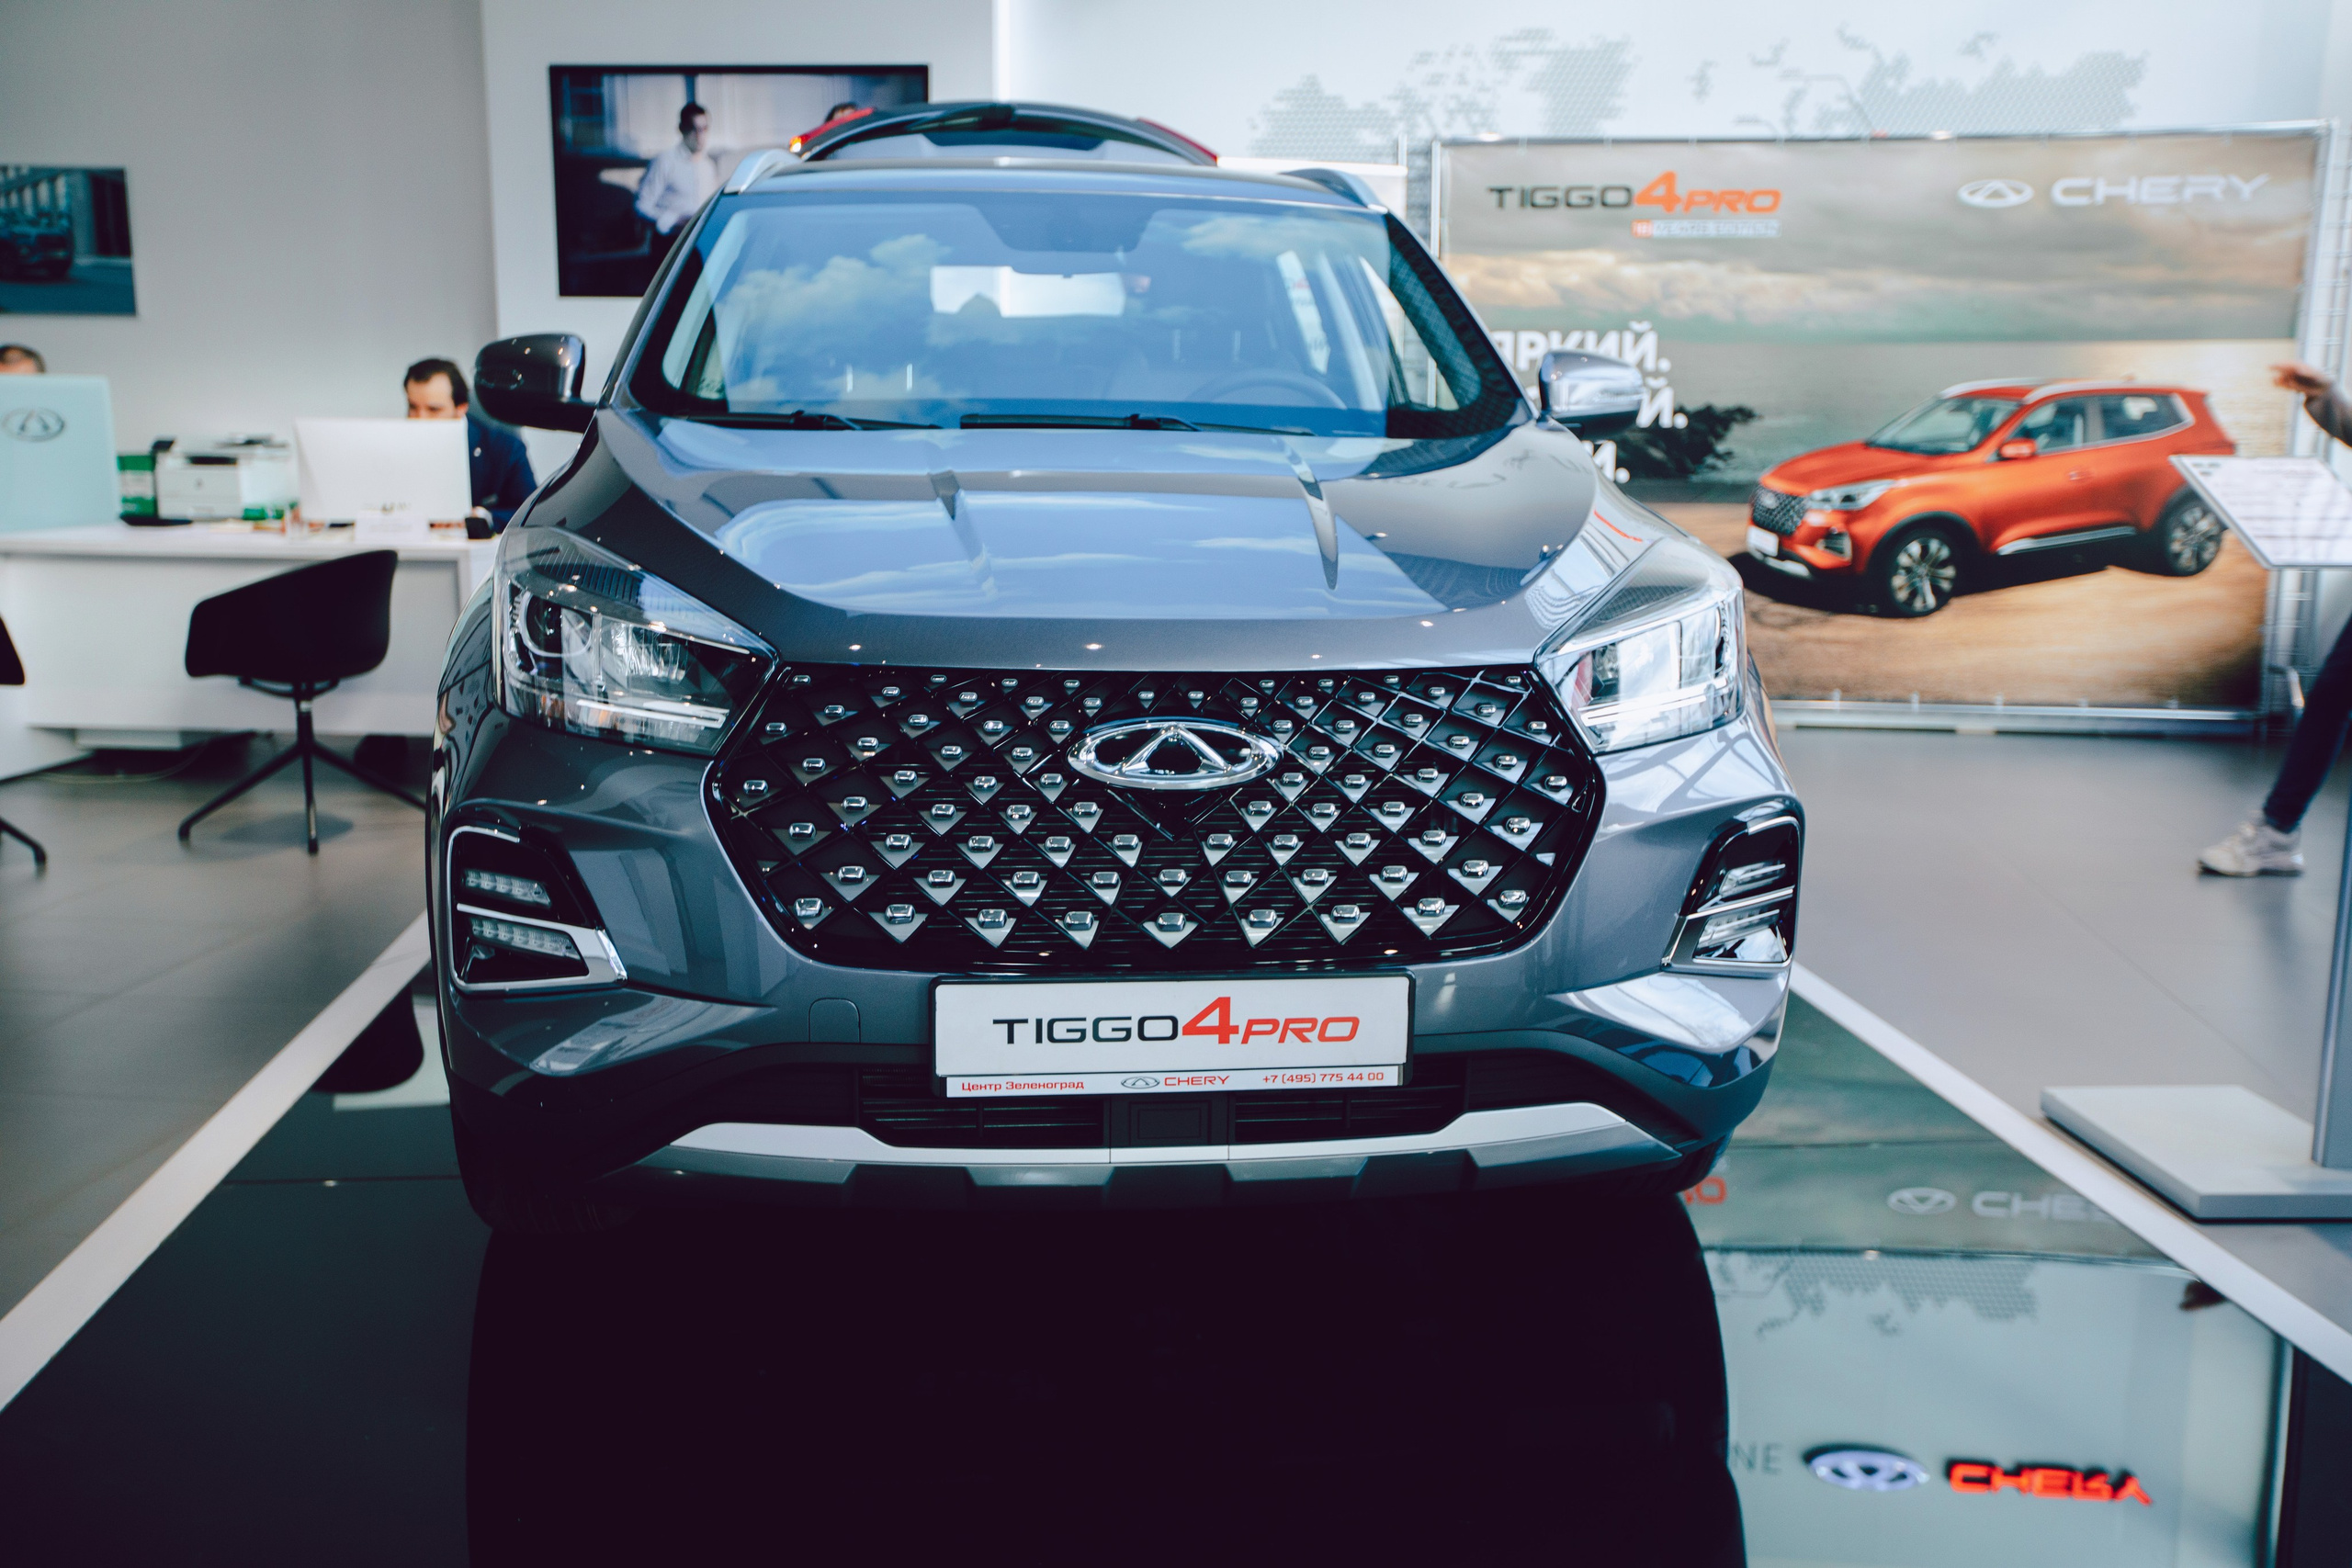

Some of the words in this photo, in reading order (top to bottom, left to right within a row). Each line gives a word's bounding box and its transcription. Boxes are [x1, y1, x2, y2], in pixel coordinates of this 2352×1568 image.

[2050, 173, 2271, 207] CHERY
[1164, 1075, 1230, 1087] CHERY
[1262, 1074, 1278, 1084] +7
[1282, 1073, 1317, 1084] (495)
[1319, 1073, 1343, 1082] 775
[1347, 1072, 1364, 1081] 44
[1367, 1071, 1385, 1081] 00
[961, 1081, 1002, 1092] Центр
[1005, 1080, 1084, 1091] Зеленоград
